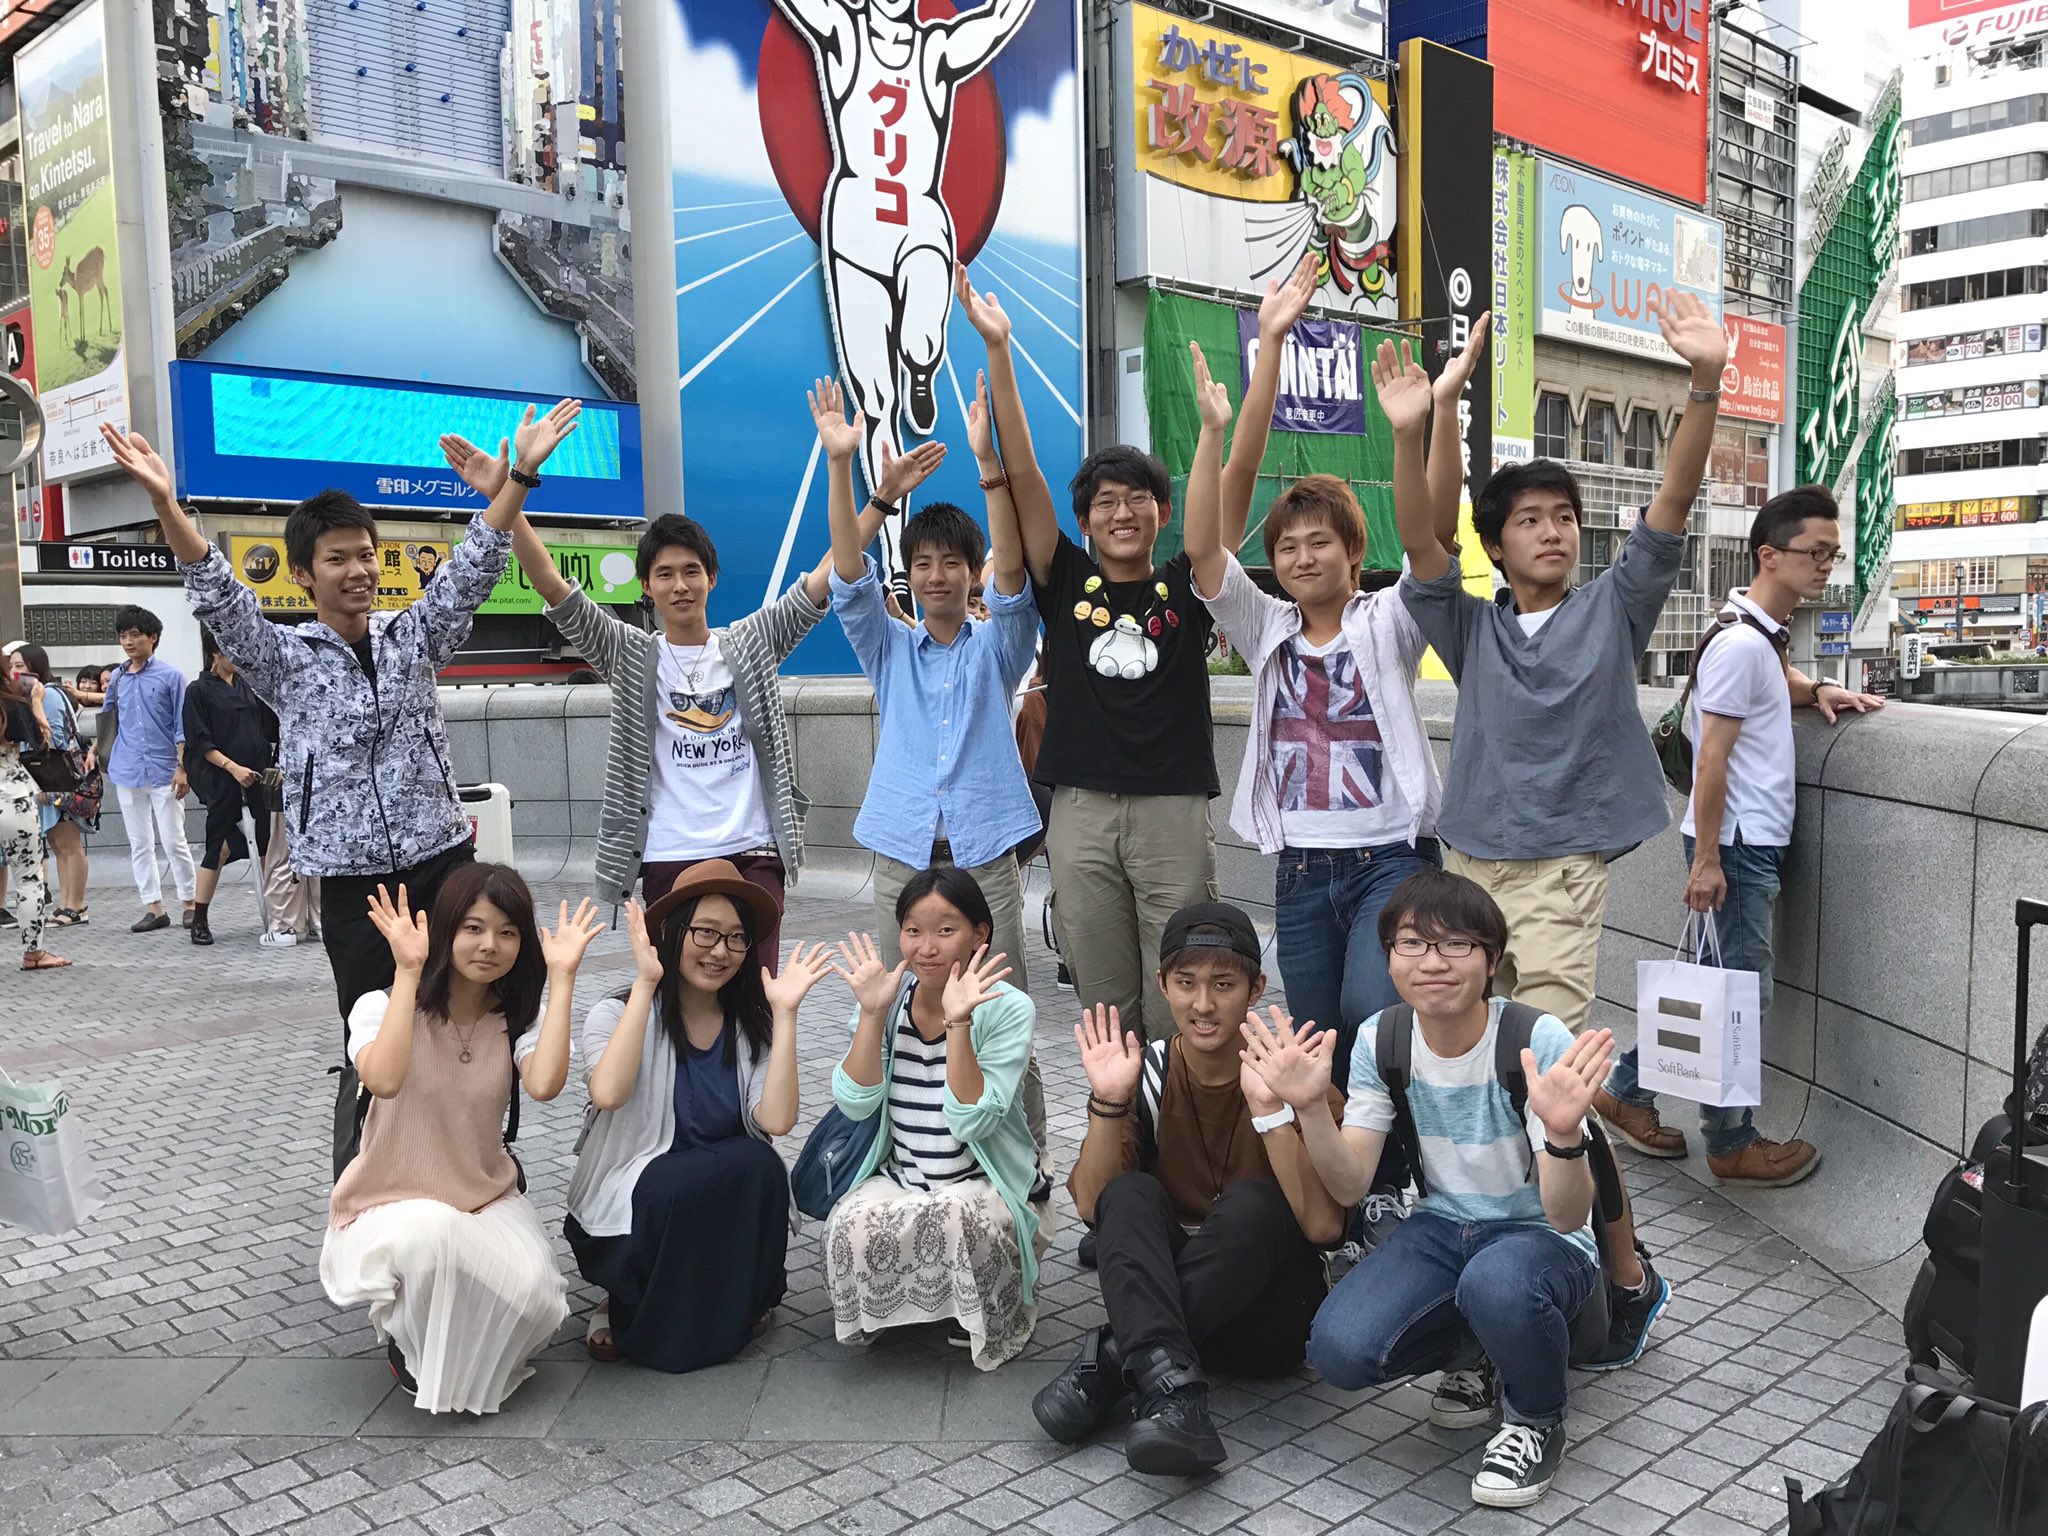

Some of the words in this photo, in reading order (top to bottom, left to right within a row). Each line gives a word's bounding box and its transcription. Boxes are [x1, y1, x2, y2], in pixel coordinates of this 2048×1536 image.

[1160, 24, 1268, 94] かぜに
[1640, 29, 1701, 95] プロミス
[26, 115, 62, 160] Travel
[64, 121, 73, 139] to
[72, 94, 104, 133] Nara
[1147, 79, 1280, 177] 改源
[868, 77, 911, 226] グリコ
[29, 184, 40, 201] on
[40, 145, 96, 194] Kintetsu.
[1611, 202, 1661, 230] お買物のたびに
[38, 227, 50, 251] 35
[1611, 250, 1668, 275] おトクな電子マネー
[1494, 156, 1509, 428] 株式会社日本リート
[1247, 333, 1358, 401] CINTAI
[1285, 407, 1325, 423] 意匠変更中
[1493, 441, 1526, 459] NIHON
[376, 477, 478, 498] 雪印メグミルク
[98, 549, 167, 568] Toilets
[261, 593, 309, 608] 株式会社
[728, 726, 735, 734] IN
[672, 740, 706, 760] NEW
[711, 733, 746, 758] YORK
[1732, 1025, 1741, 1066] SoftBank
[1657, 1058, 1700, 1081] SoftBank
